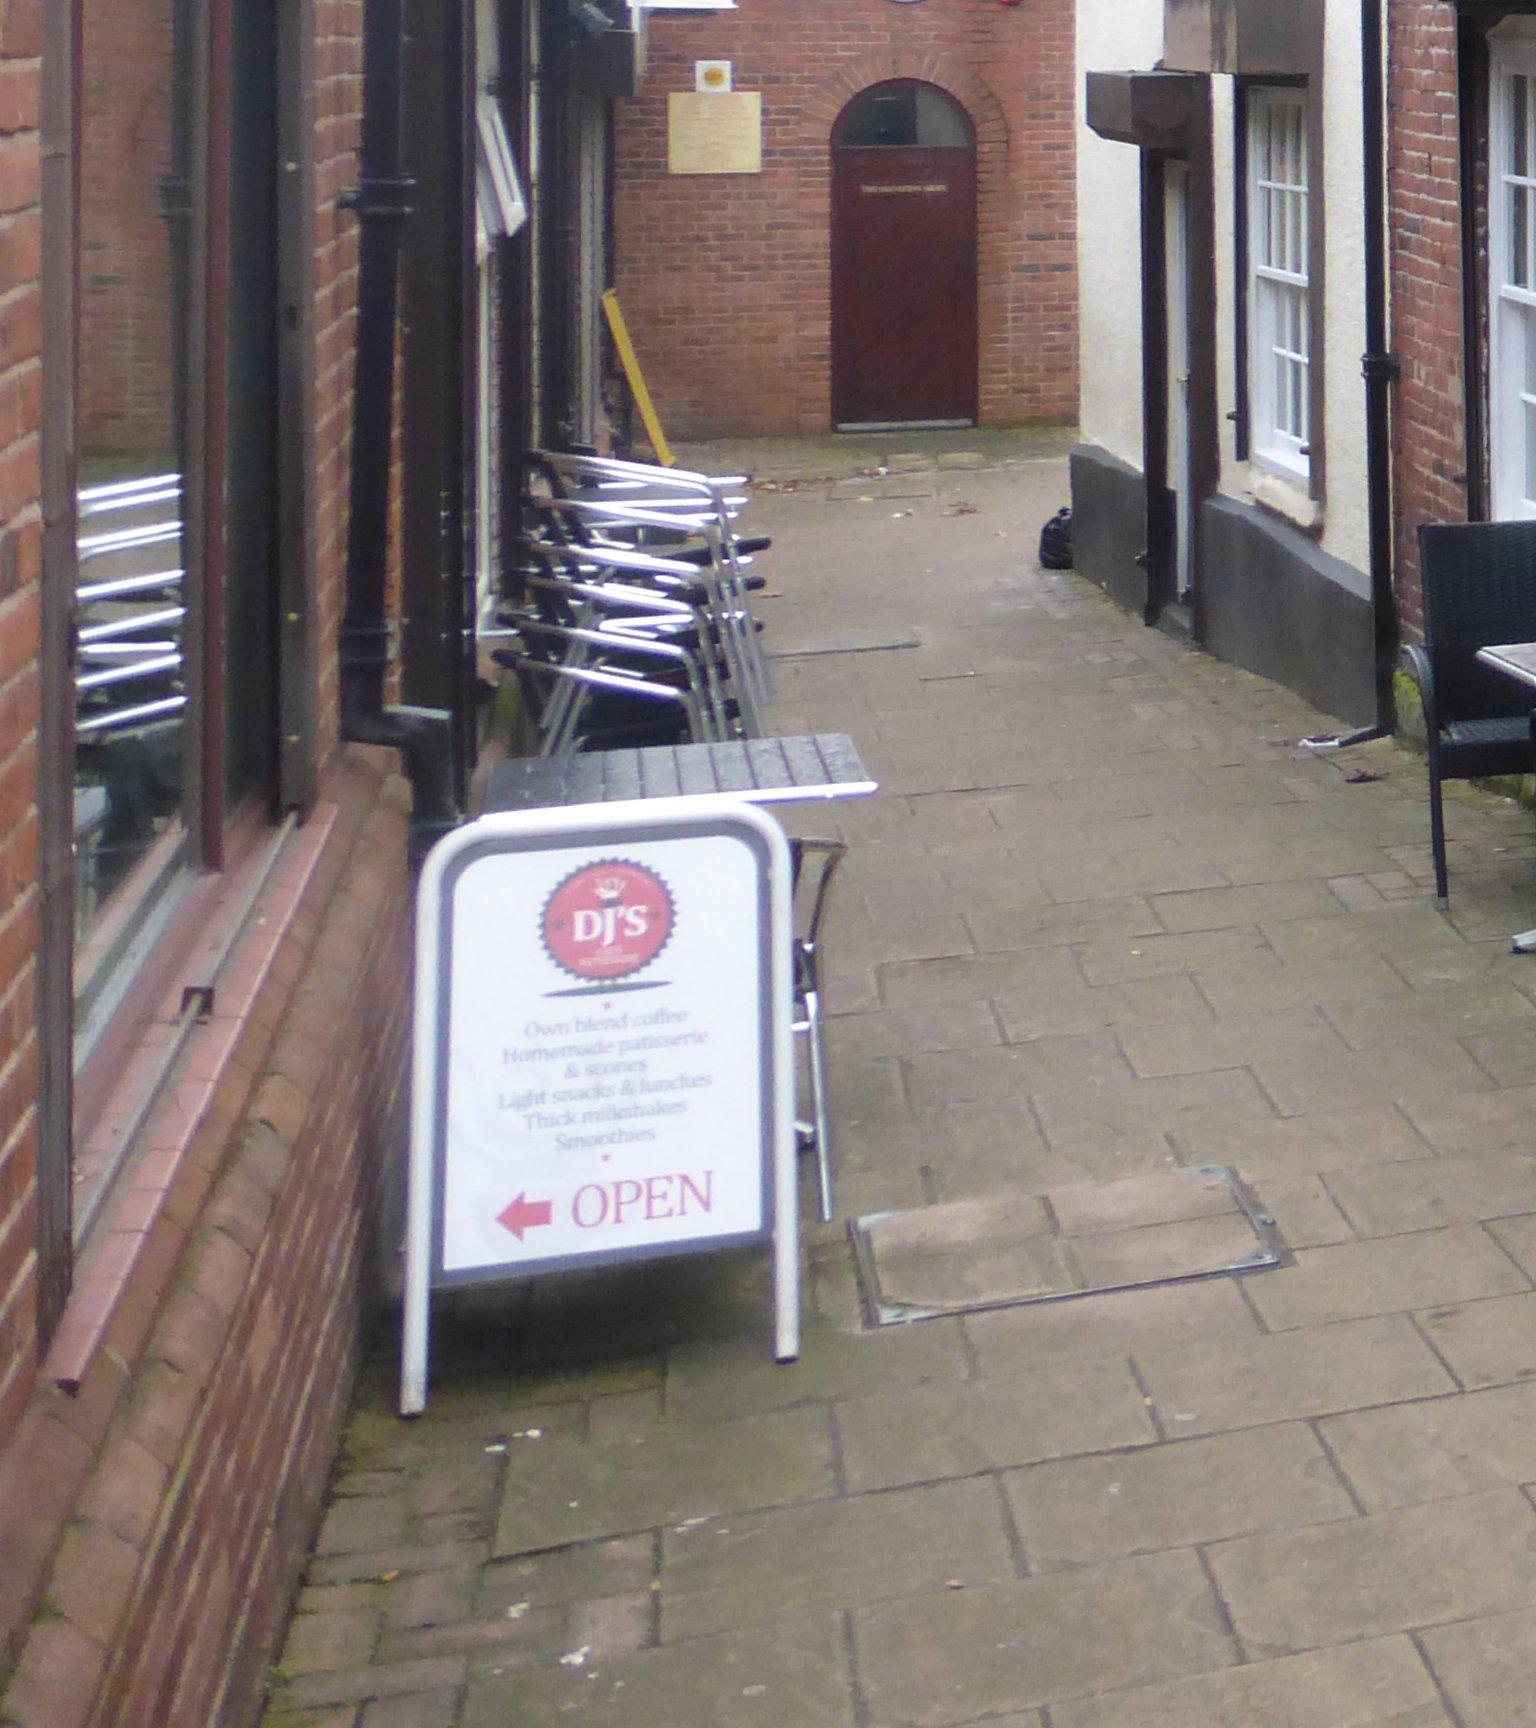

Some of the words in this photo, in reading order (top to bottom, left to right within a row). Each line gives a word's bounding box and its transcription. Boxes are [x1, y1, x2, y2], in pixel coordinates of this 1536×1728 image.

[572, 905, 649, 947] DJ'S
[524, 1021, 570, 1038] Own
[575, 1013, 627, 1034] blend
[633, 1007, 689, 1027] coffee
[502, 1040, 614, 1064] Homemade
[619, 1030, 710, 1057] patisserie
[564, 1063, 579, 1079] &
[585, 1059, 648, 1077] scones
[498, 1091, 547, 1113] Light
[552, 1082, 615, 1104] snacks
[620, 1079, 635, 1096] &
[640, 1074, 713, 1094] lunches
[523, 1111, 575, 1131] Thick
[582, 1100, 688, 1124] milkshakes
[555, 1127, 656, 1151] Smoothies
[571, 1169, 715, 1229] OPEN
